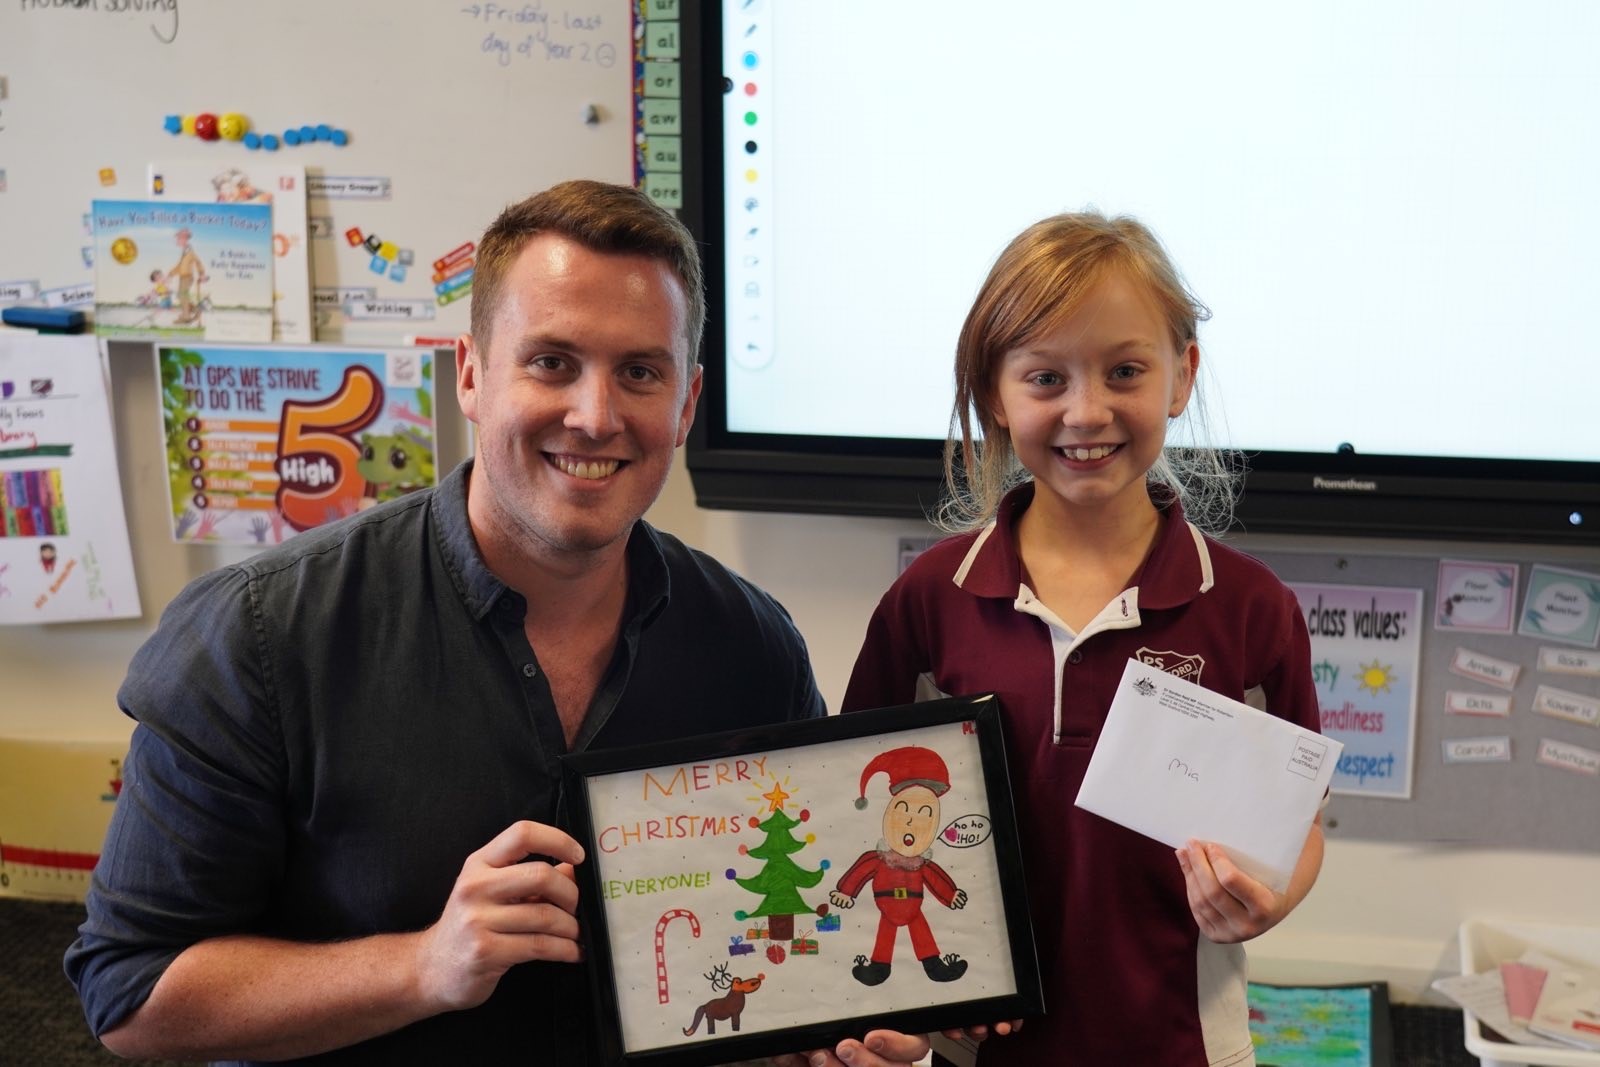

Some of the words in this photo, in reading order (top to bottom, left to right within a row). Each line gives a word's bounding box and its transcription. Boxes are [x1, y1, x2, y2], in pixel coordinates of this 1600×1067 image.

[657, 32, 675, 48] al
[654, 76, 674, 88] or
[650, 113, 676, 125] aw
[655, 150, 677, 163] au
[651, 187, 679, 199] ore
[99, 215, 125, 229] Have
[128, 211, 148, 225] You
[150, 211, 178, 224] Filled
[180, 215, 187, 224] a
[189, 211, 224, 226] Bucket
[228, 214, 267, 233] Today?
[365, 304, 412, 317] Writing
[184, 366, 201, 385] AT
[207, 366, 235, 388] GPS
[240, 367, 263, 388] WE
[267, 368, 321, 391] STRIVE
[185, 388, 205, 409] TO
[210, 389, 231, 410] DO
[236, 390, 266, 411] THE
[275, 363, 385, 532] 5
[280, 458, 335, 486] High
[1313, 476, 1377, 491] Promethean
[1308, 595, 1347, 638] class
[1353, 597, 1408, 641] values:
[1297, 745, 1321, 760] POSTAGE
[1301, 753, 1314, 763] PAID
[1292, 756, 1320, 771] AUSTRALIA
[644, 756, 767, 801] MERRY
[954, 822, 968, 830] ho
[971, 819, 984, 830] ho
[598, 815, 741, 853] CHRISTMAS
